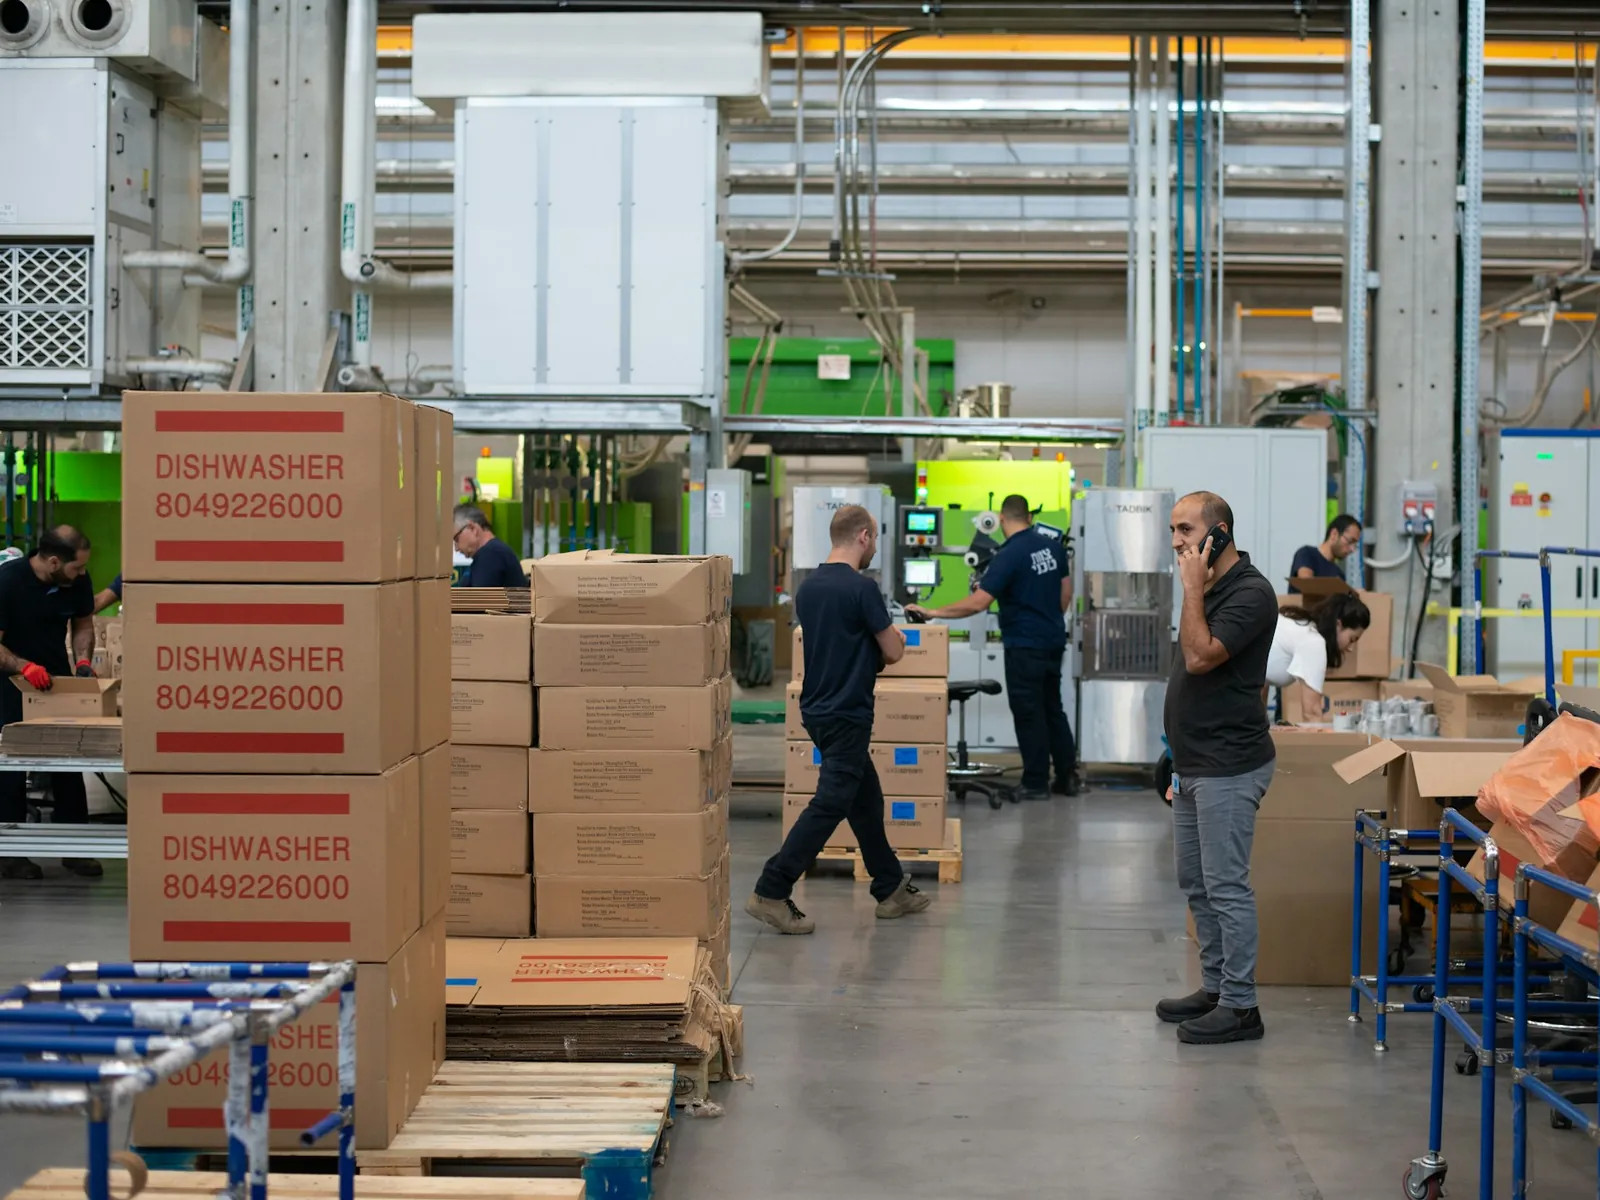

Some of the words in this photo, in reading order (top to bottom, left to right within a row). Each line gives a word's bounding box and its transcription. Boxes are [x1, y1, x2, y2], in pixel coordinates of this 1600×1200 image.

[156, 453, 344, 480] DISHWASHER
[156, 492, 343, 519] 8049226000
[1115, 504, 1153, 513] TADBIK
[157, 646, 344, 673] DISHWASHER
[157, 685, 343, 711] 8049226000
[164, 836, 351, 862] DISHWASHER
[164, 874, 350, 900] 8049226000
